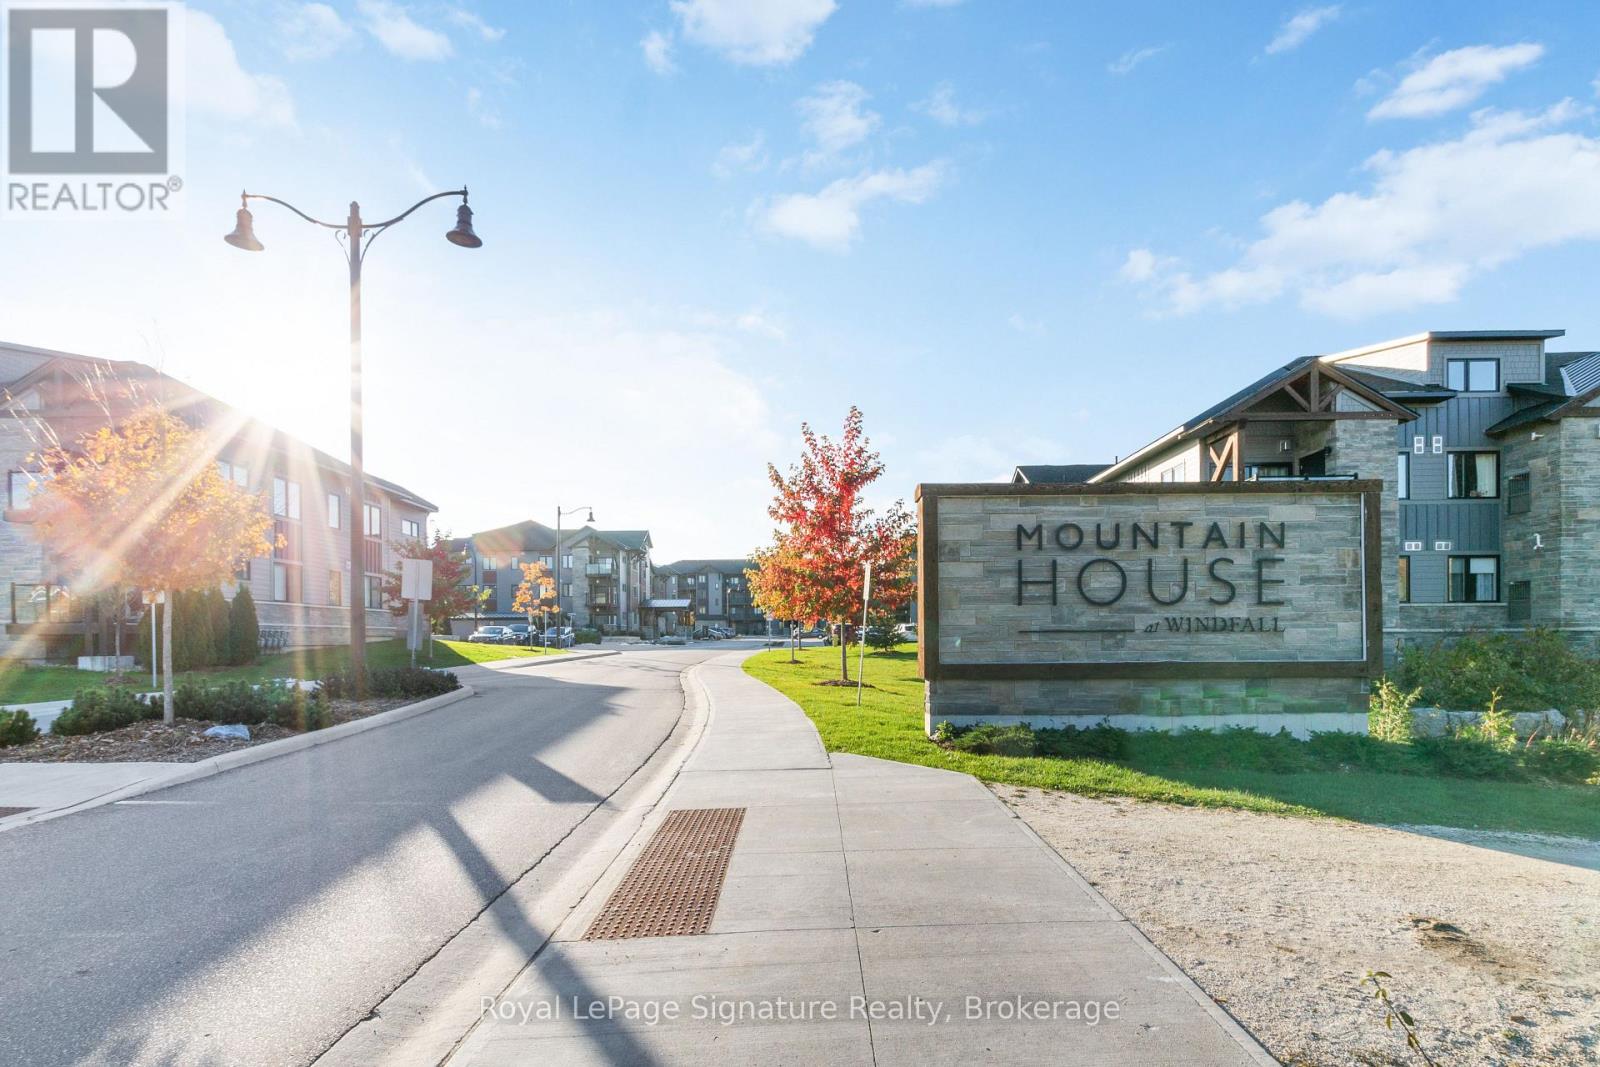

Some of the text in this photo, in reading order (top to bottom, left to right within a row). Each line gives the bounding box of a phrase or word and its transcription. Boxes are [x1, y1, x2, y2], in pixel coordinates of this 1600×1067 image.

[1016, 521, 1286, 551] MOUNTAIN
[1017, 557, 1285, 606] HOUSE
[1143, 616, 1286, 633] at WINDFALL
